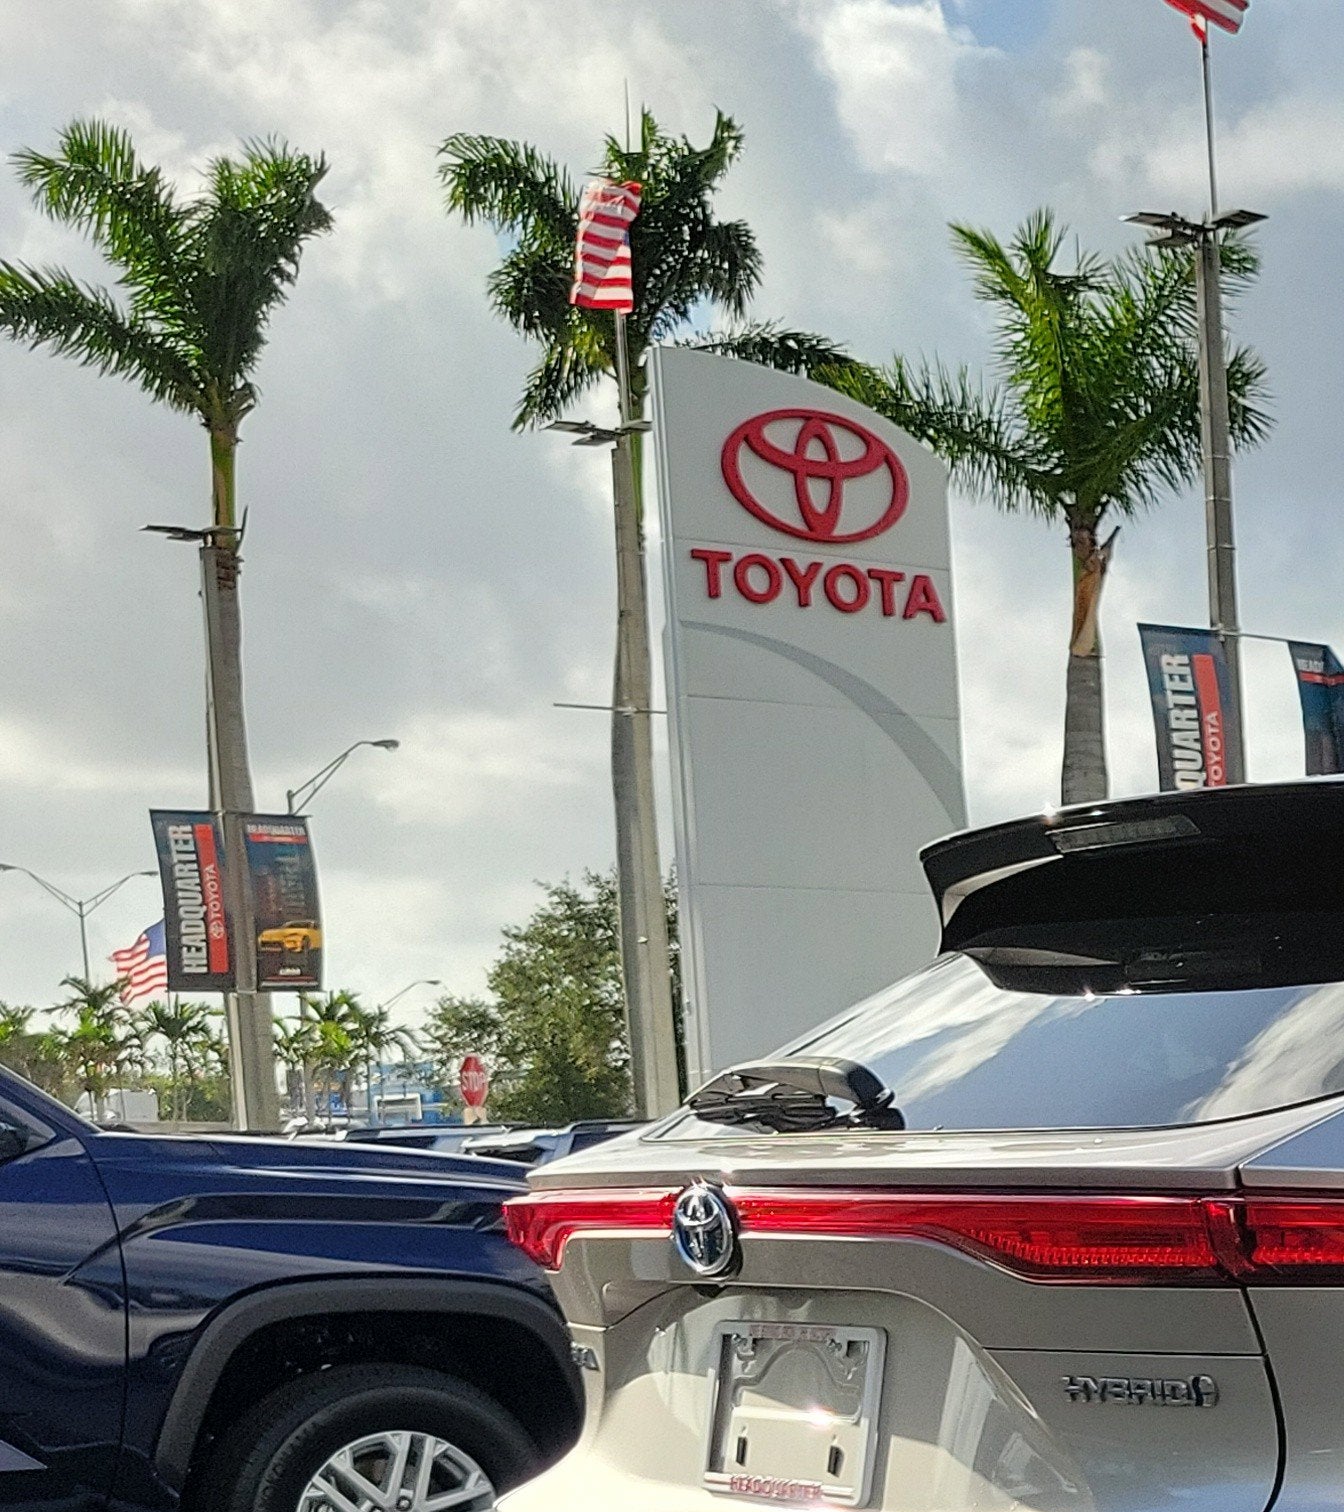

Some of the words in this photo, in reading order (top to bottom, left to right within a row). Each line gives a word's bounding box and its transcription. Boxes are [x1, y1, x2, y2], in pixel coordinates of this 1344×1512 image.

[690, 548, 947, 624] TOYOTA
[168, 824, 209, 974] HEADQUARTER
[203, 864, 221, 922] TOYOTA
[461, 1070, 486, 1092] STOP
[1061, 1374, 1191, 1406] HYBRID
